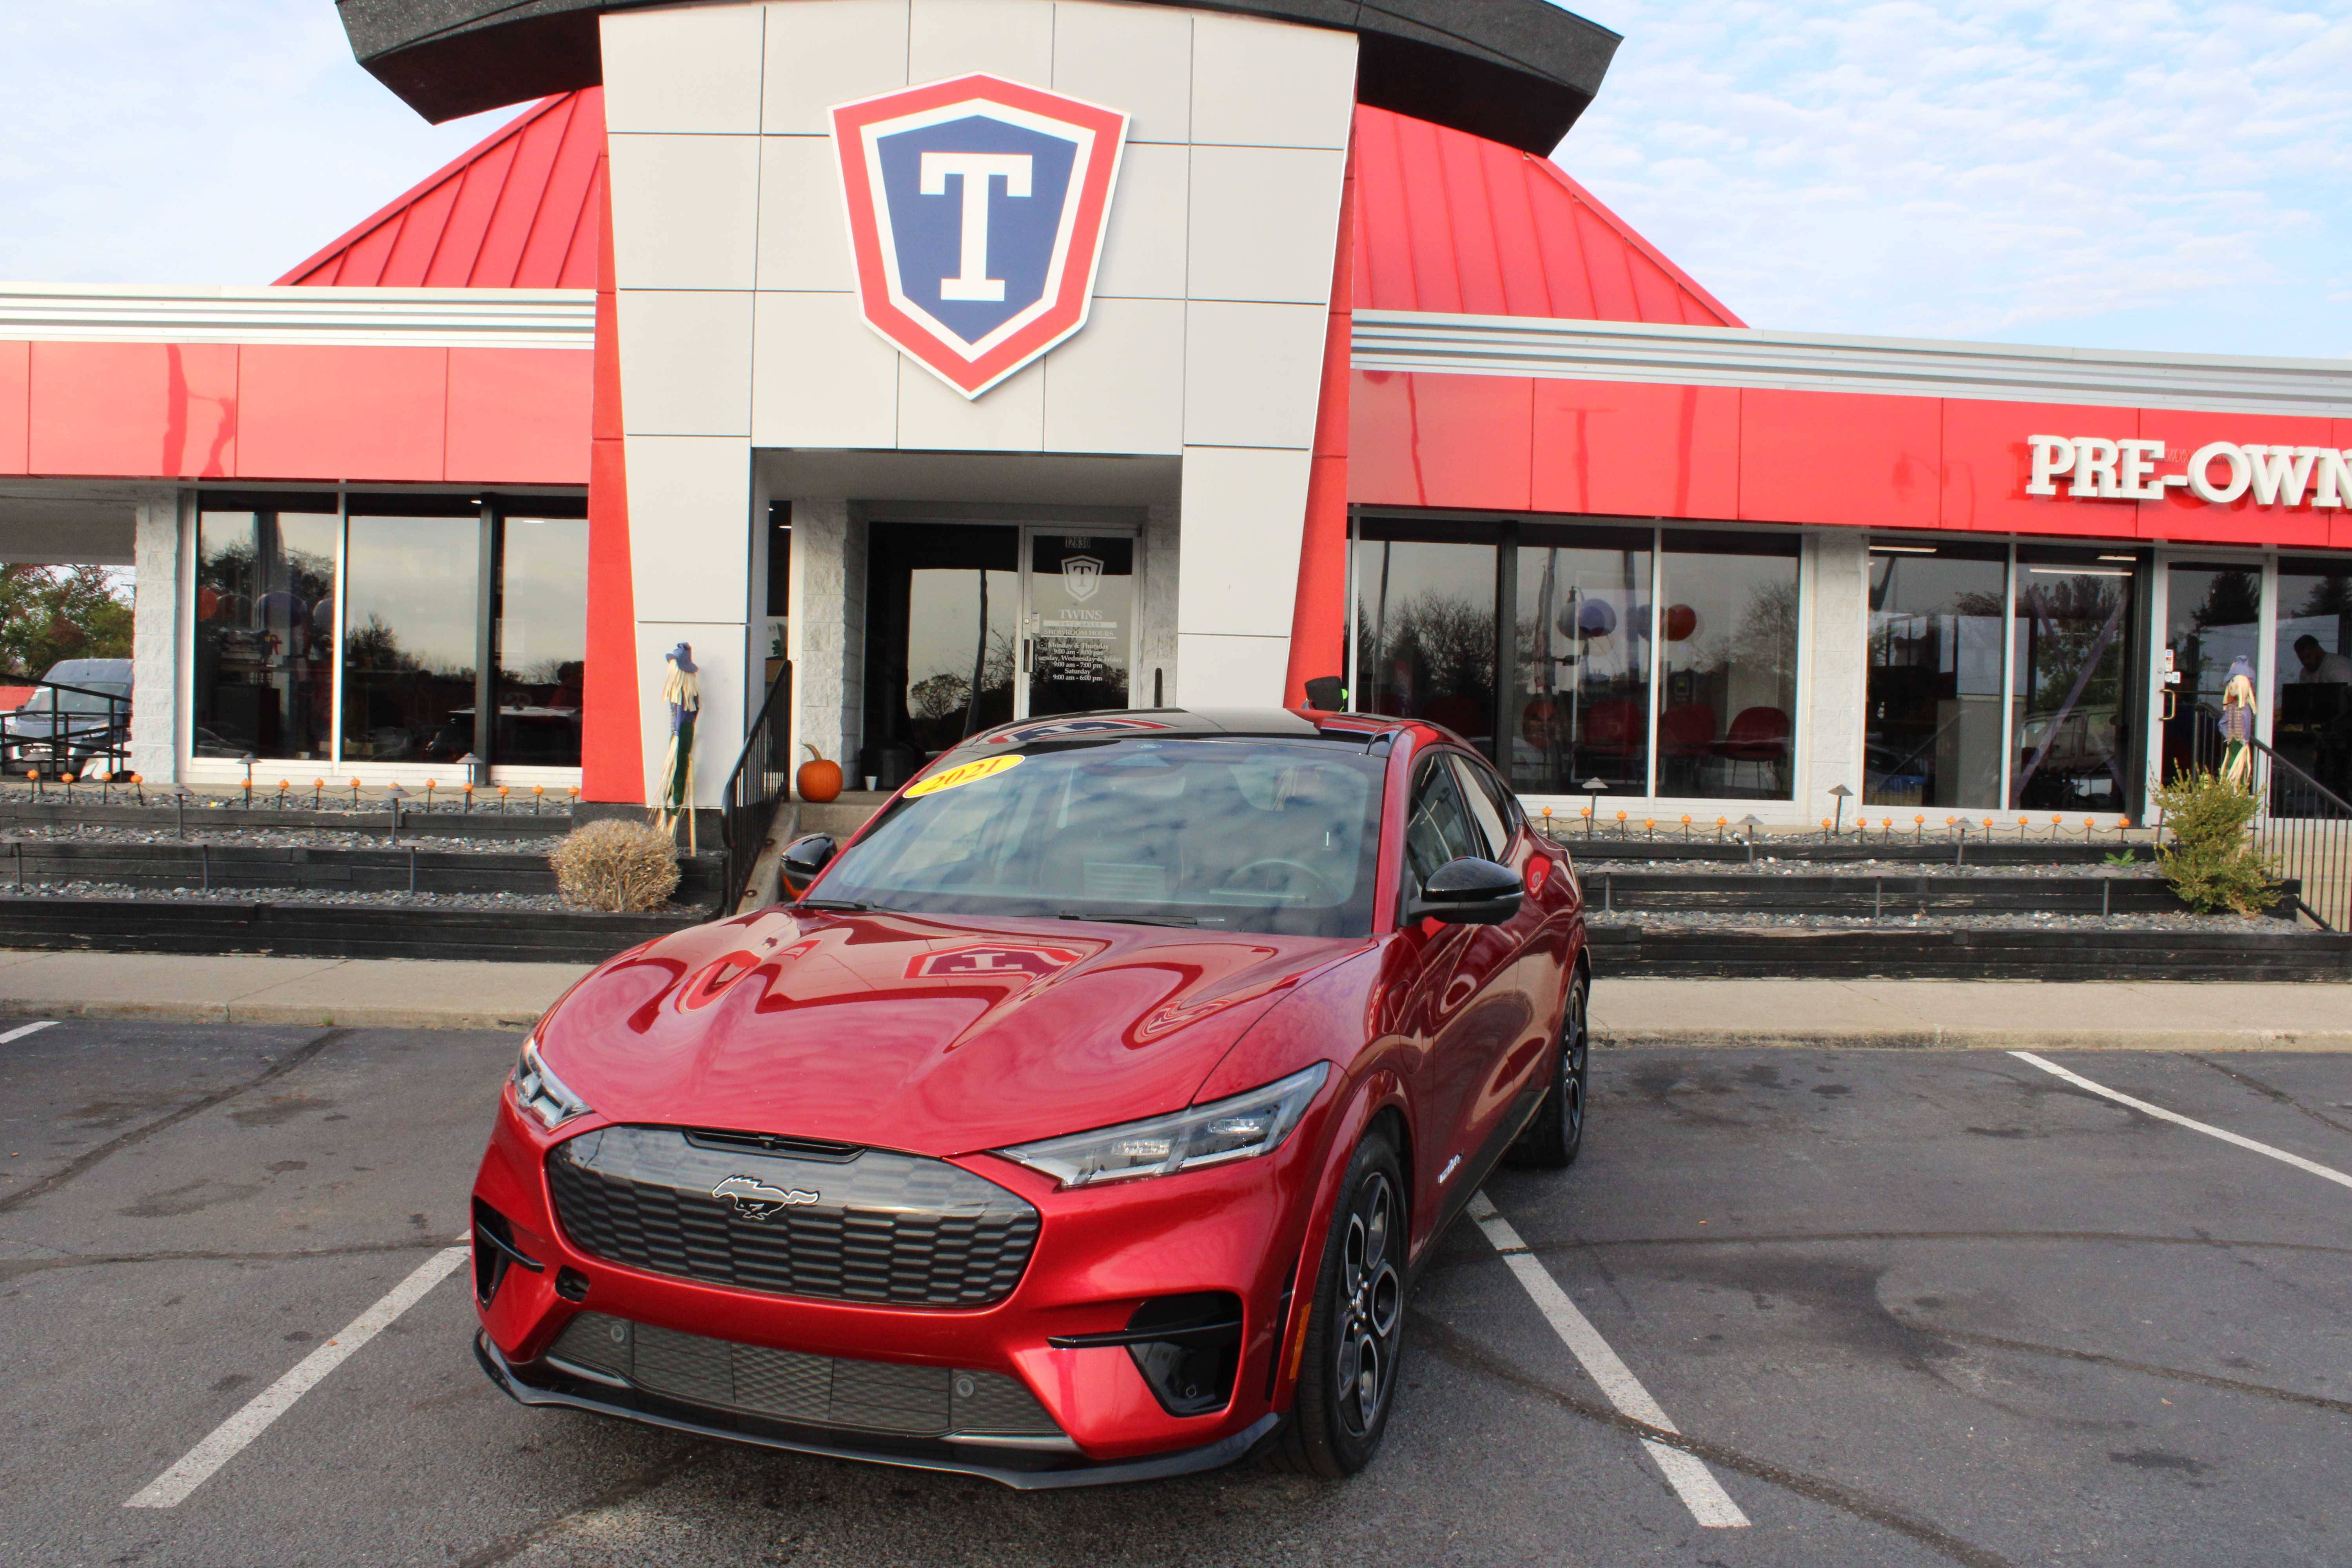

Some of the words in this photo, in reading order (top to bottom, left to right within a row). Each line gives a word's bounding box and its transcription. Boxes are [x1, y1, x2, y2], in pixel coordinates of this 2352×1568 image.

[920, 152, 1033, 301] T
[1066, 537, 1091, 548] 12830
[1073, 566, 1092, 587] T
[1059, 609, 1102, 620] TWINS
[922, 759, 1003, 793] 2021
